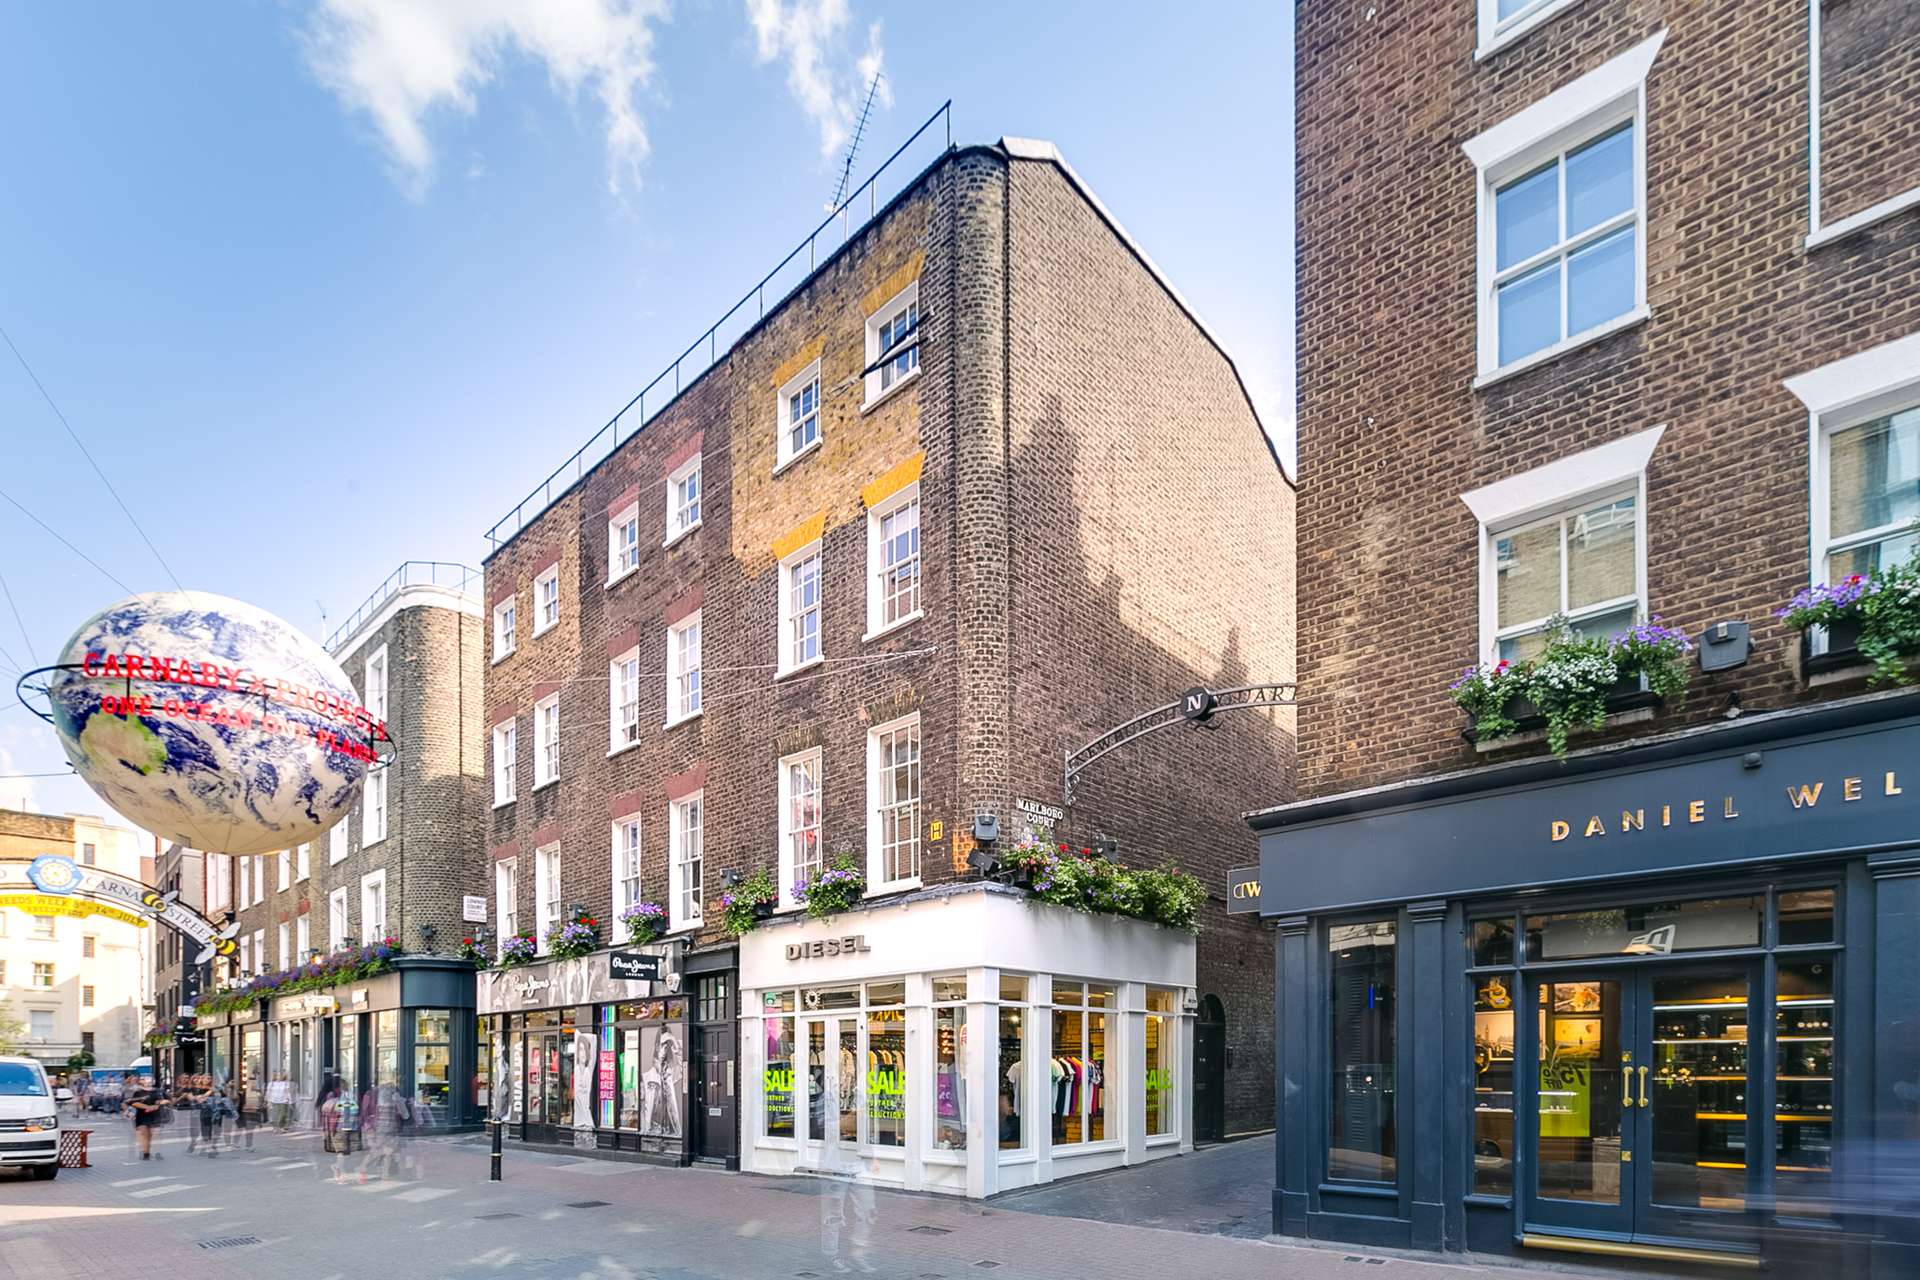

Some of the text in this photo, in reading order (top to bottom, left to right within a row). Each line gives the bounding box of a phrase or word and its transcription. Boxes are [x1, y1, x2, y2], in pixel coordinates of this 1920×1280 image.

[82, 652, 243, 691] CARNABY
[276, 678, 375, 733] PROJECT
[1186, 693, 1203, 712] N
[101, 695, 153, 715] ONE
[164, 699, 252, 727] OCEAN
[262, 713, 311, 744] ONE
[1026, 812, 1056, 828] COURT
[1551, 796, 1739, 841] DANIEL
[786, 935, 871, 961] DIESEL
[764, 1070, 796, 1092] SALE
[866, 1071, 906, 1095] SALE
